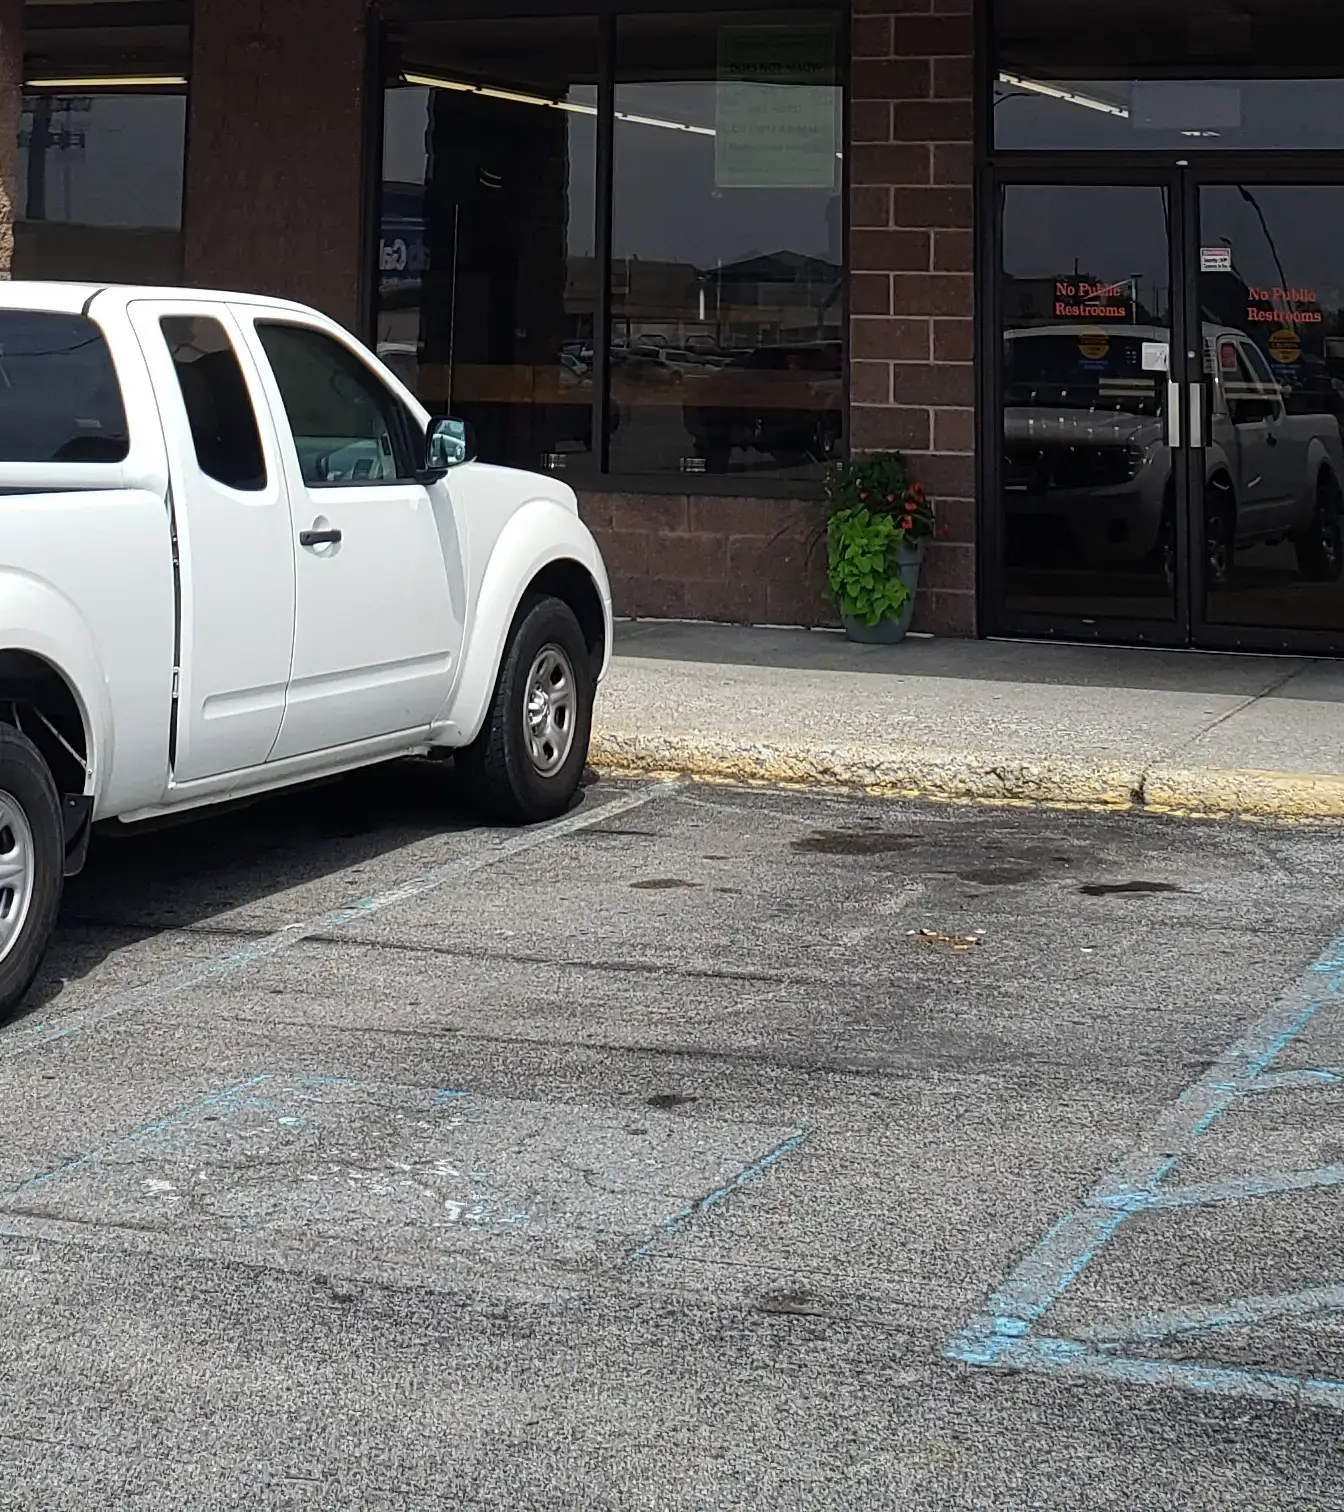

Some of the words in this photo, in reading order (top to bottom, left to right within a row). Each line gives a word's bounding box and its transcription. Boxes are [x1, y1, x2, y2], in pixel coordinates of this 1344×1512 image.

[1056, 282, 1074, 296] No
[1078, 282, 1121, 297] Public
[1248, 287, 1268, 301] No
[1273, 287, 1316, 302] Public
[1056, 302, 1126, 317] Restrooms
[1247, 307, 1322, 322] Restrooms
